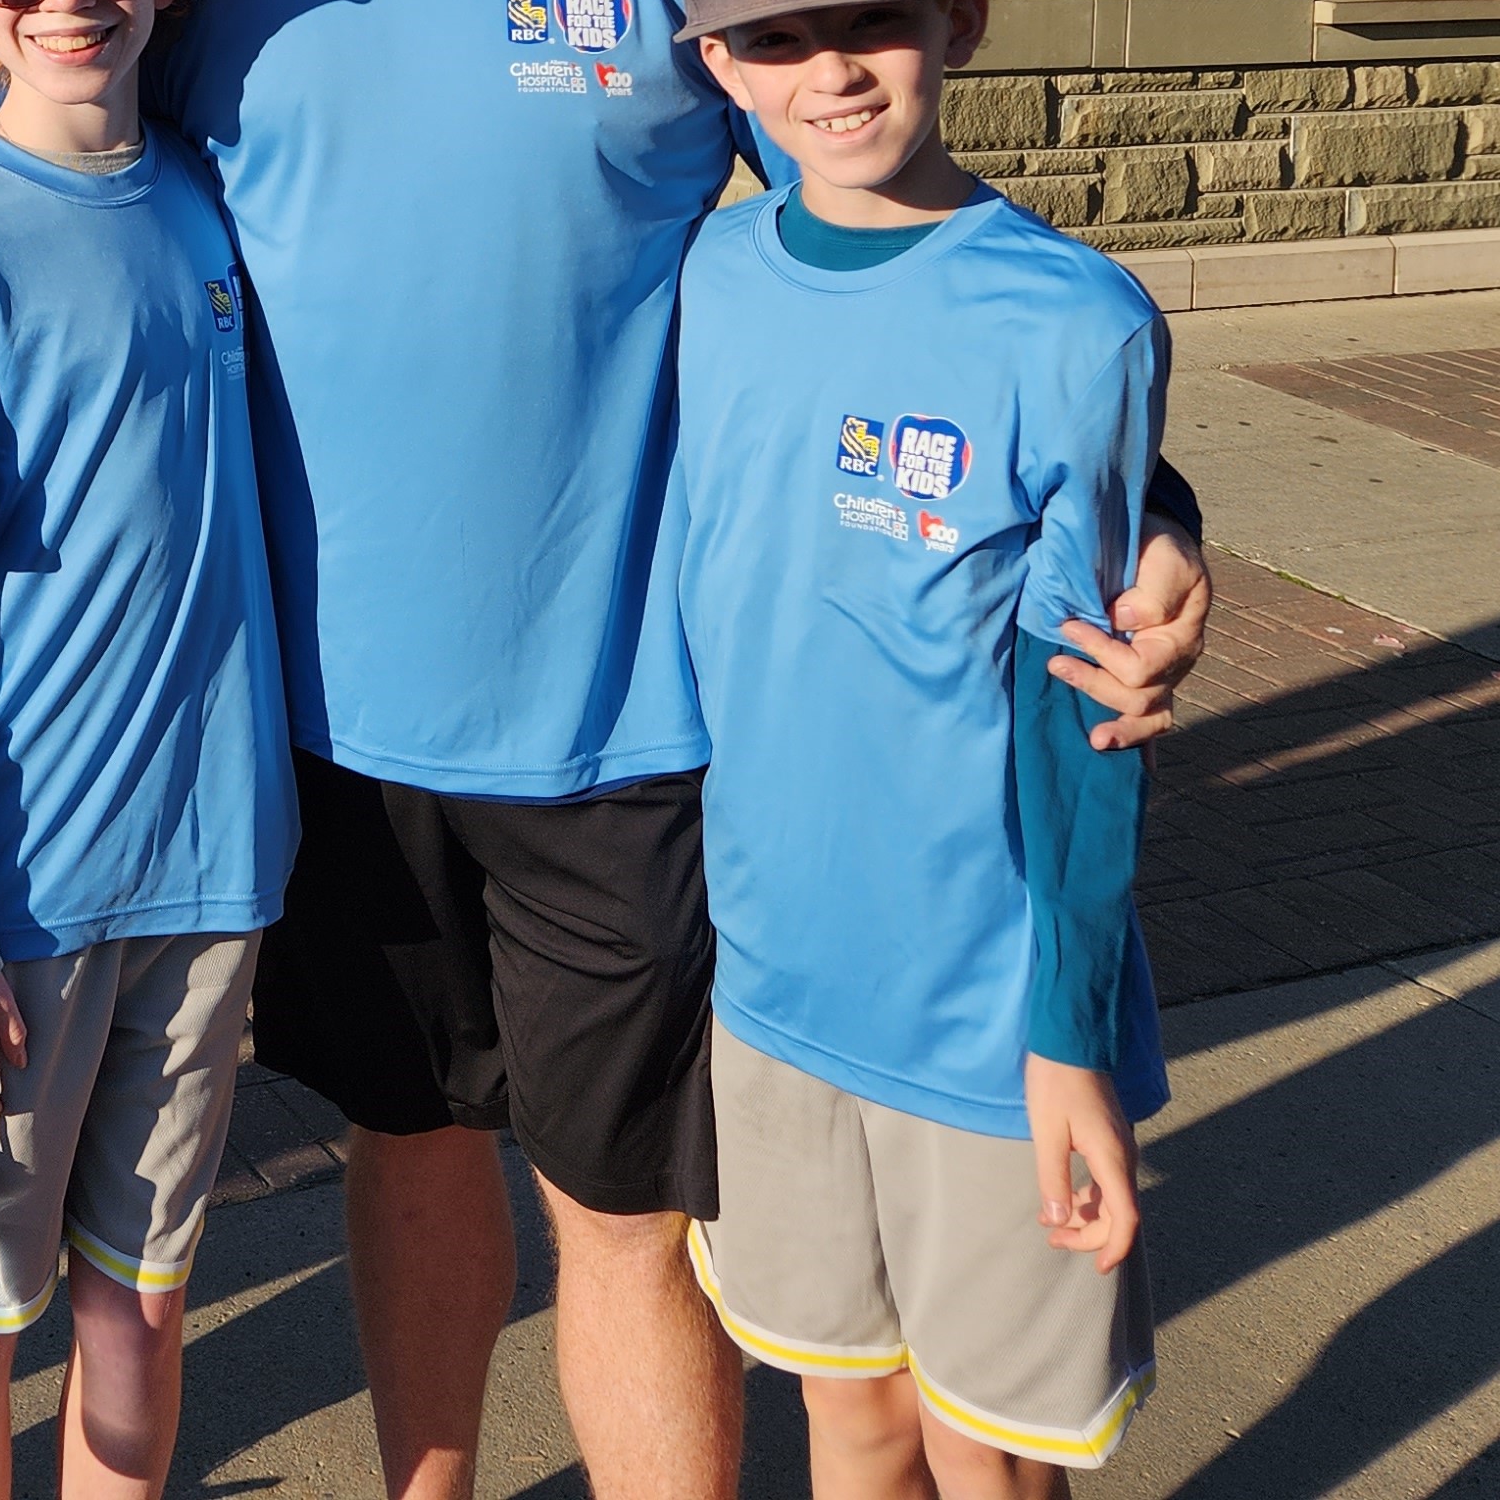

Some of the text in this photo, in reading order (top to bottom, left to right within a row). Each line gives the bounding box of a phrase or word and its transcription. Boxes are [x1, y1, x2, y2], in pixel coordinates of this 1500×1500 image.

[566, 15, 615, 28] FOR THE
[511, 29, 546, 41] RBC
[567, 27, 617, 49] KIDS
[510, 62, 583, 77] Children's
[518, 77, 570, 87] HOSPITAL
[605, 72, 633, 87] 100
[605, 87, 633, 98] years
[216, 315, 234, 330] RBC
[901, 427, 957, 463] RACE
[840, 456, 877, 475] RBC
[898, 453, 953, 477] FOR THE
[896, 467, 951, 498] KIDS
[833, 493, 906, 522] Children's
[840, 510, 893, 530] HOSPITAL
[927, 523, 959, 544] 100
[925, 539, 956, 553] years
